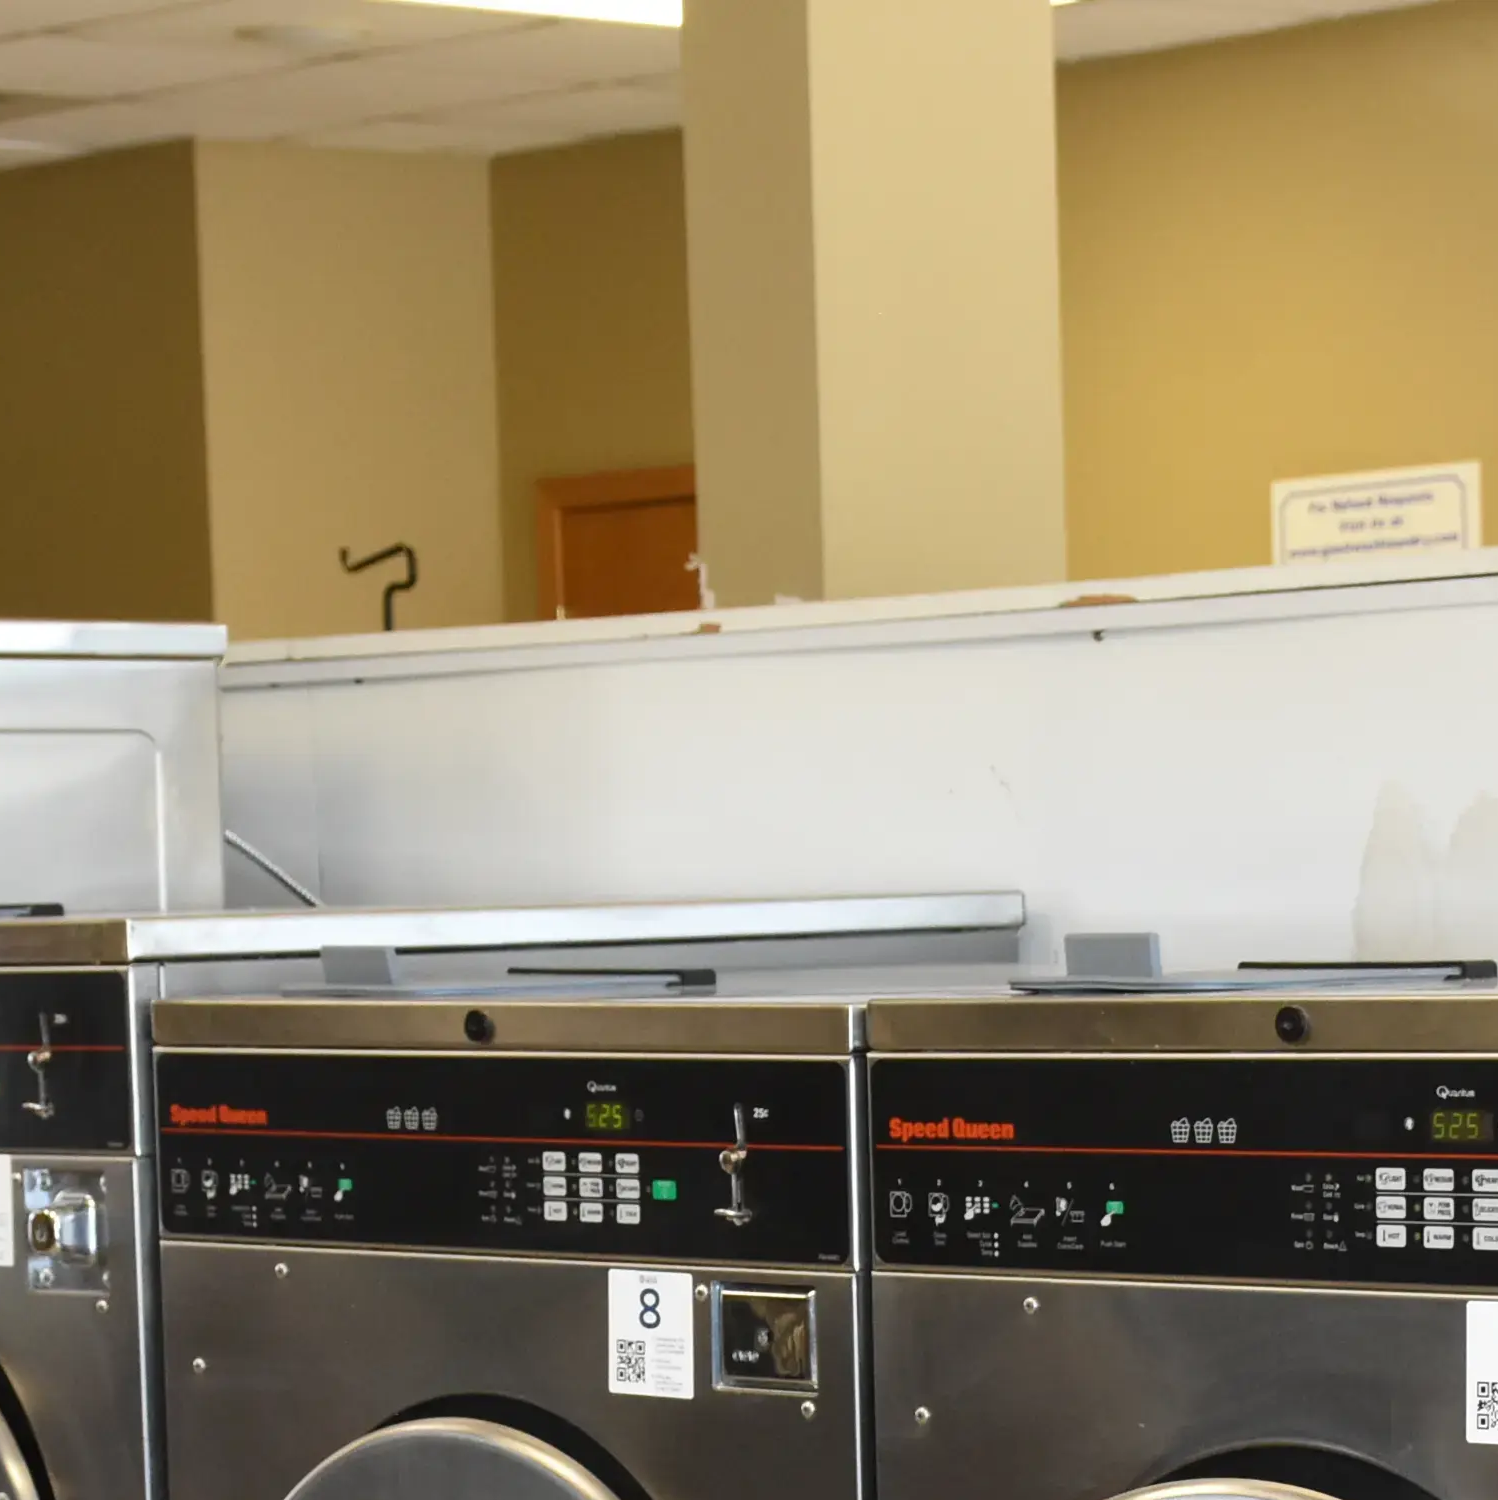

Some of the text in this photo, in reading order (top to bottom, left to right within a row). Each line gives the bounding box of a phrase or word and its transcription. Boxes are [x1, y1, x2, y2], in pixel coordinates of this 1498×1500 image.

[888, 1116, 1015, 1143] Speed Queen
[639, 1288, 661, 1329] 8
